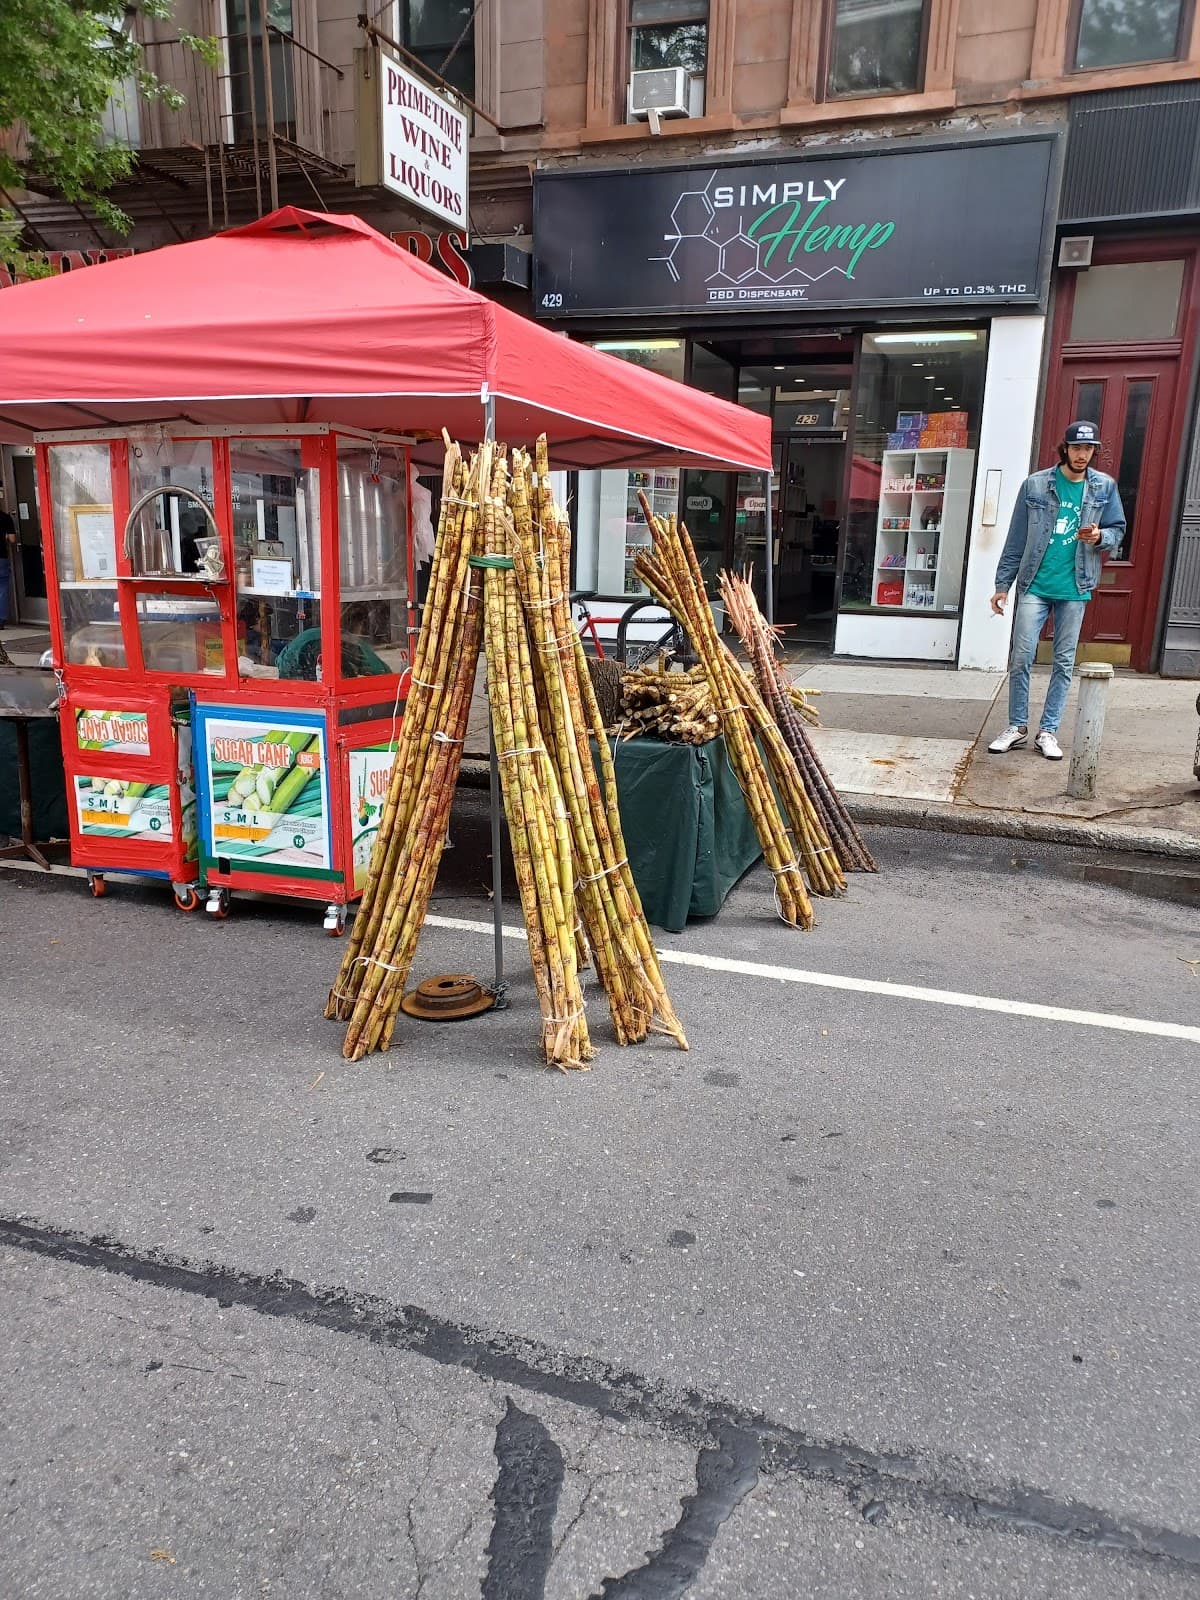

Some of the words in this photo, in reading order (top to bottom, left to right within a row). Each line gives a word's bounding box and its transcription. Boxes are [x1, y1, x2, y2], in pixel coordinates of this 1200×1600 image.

[387, 66, 462, 155] PRIMETIME
[400, 113, 452, 171] WINE
[423, 158, 431, 172] &
[389, 151, 462, 216] LIQUORS
[713, 178, 847, 209] SIMPLY
[747, 198, 895, 280] Hemp
[541, 293, 563, 308] 429
[709, 290, 734, 300] CBD
[963, 285, 995, 295] 0.3%
[999, 284, 1026, 293] THC
[797, 415, 817, 424] 429
[111, 719, 148, 744] SUGAR
[215, 738, 253, 766] SUGAR
[257, 742, 290, 767] CANE
[370, 768, 392, 797] SUG
[88, 798, 94, 807] S
[99, 799, 107, 808] M
[114, 800, 119, 809] L
[224, 812, 231, 821] S
[237, 813, 246, 823] M
[253, 815, 259, 825] L
